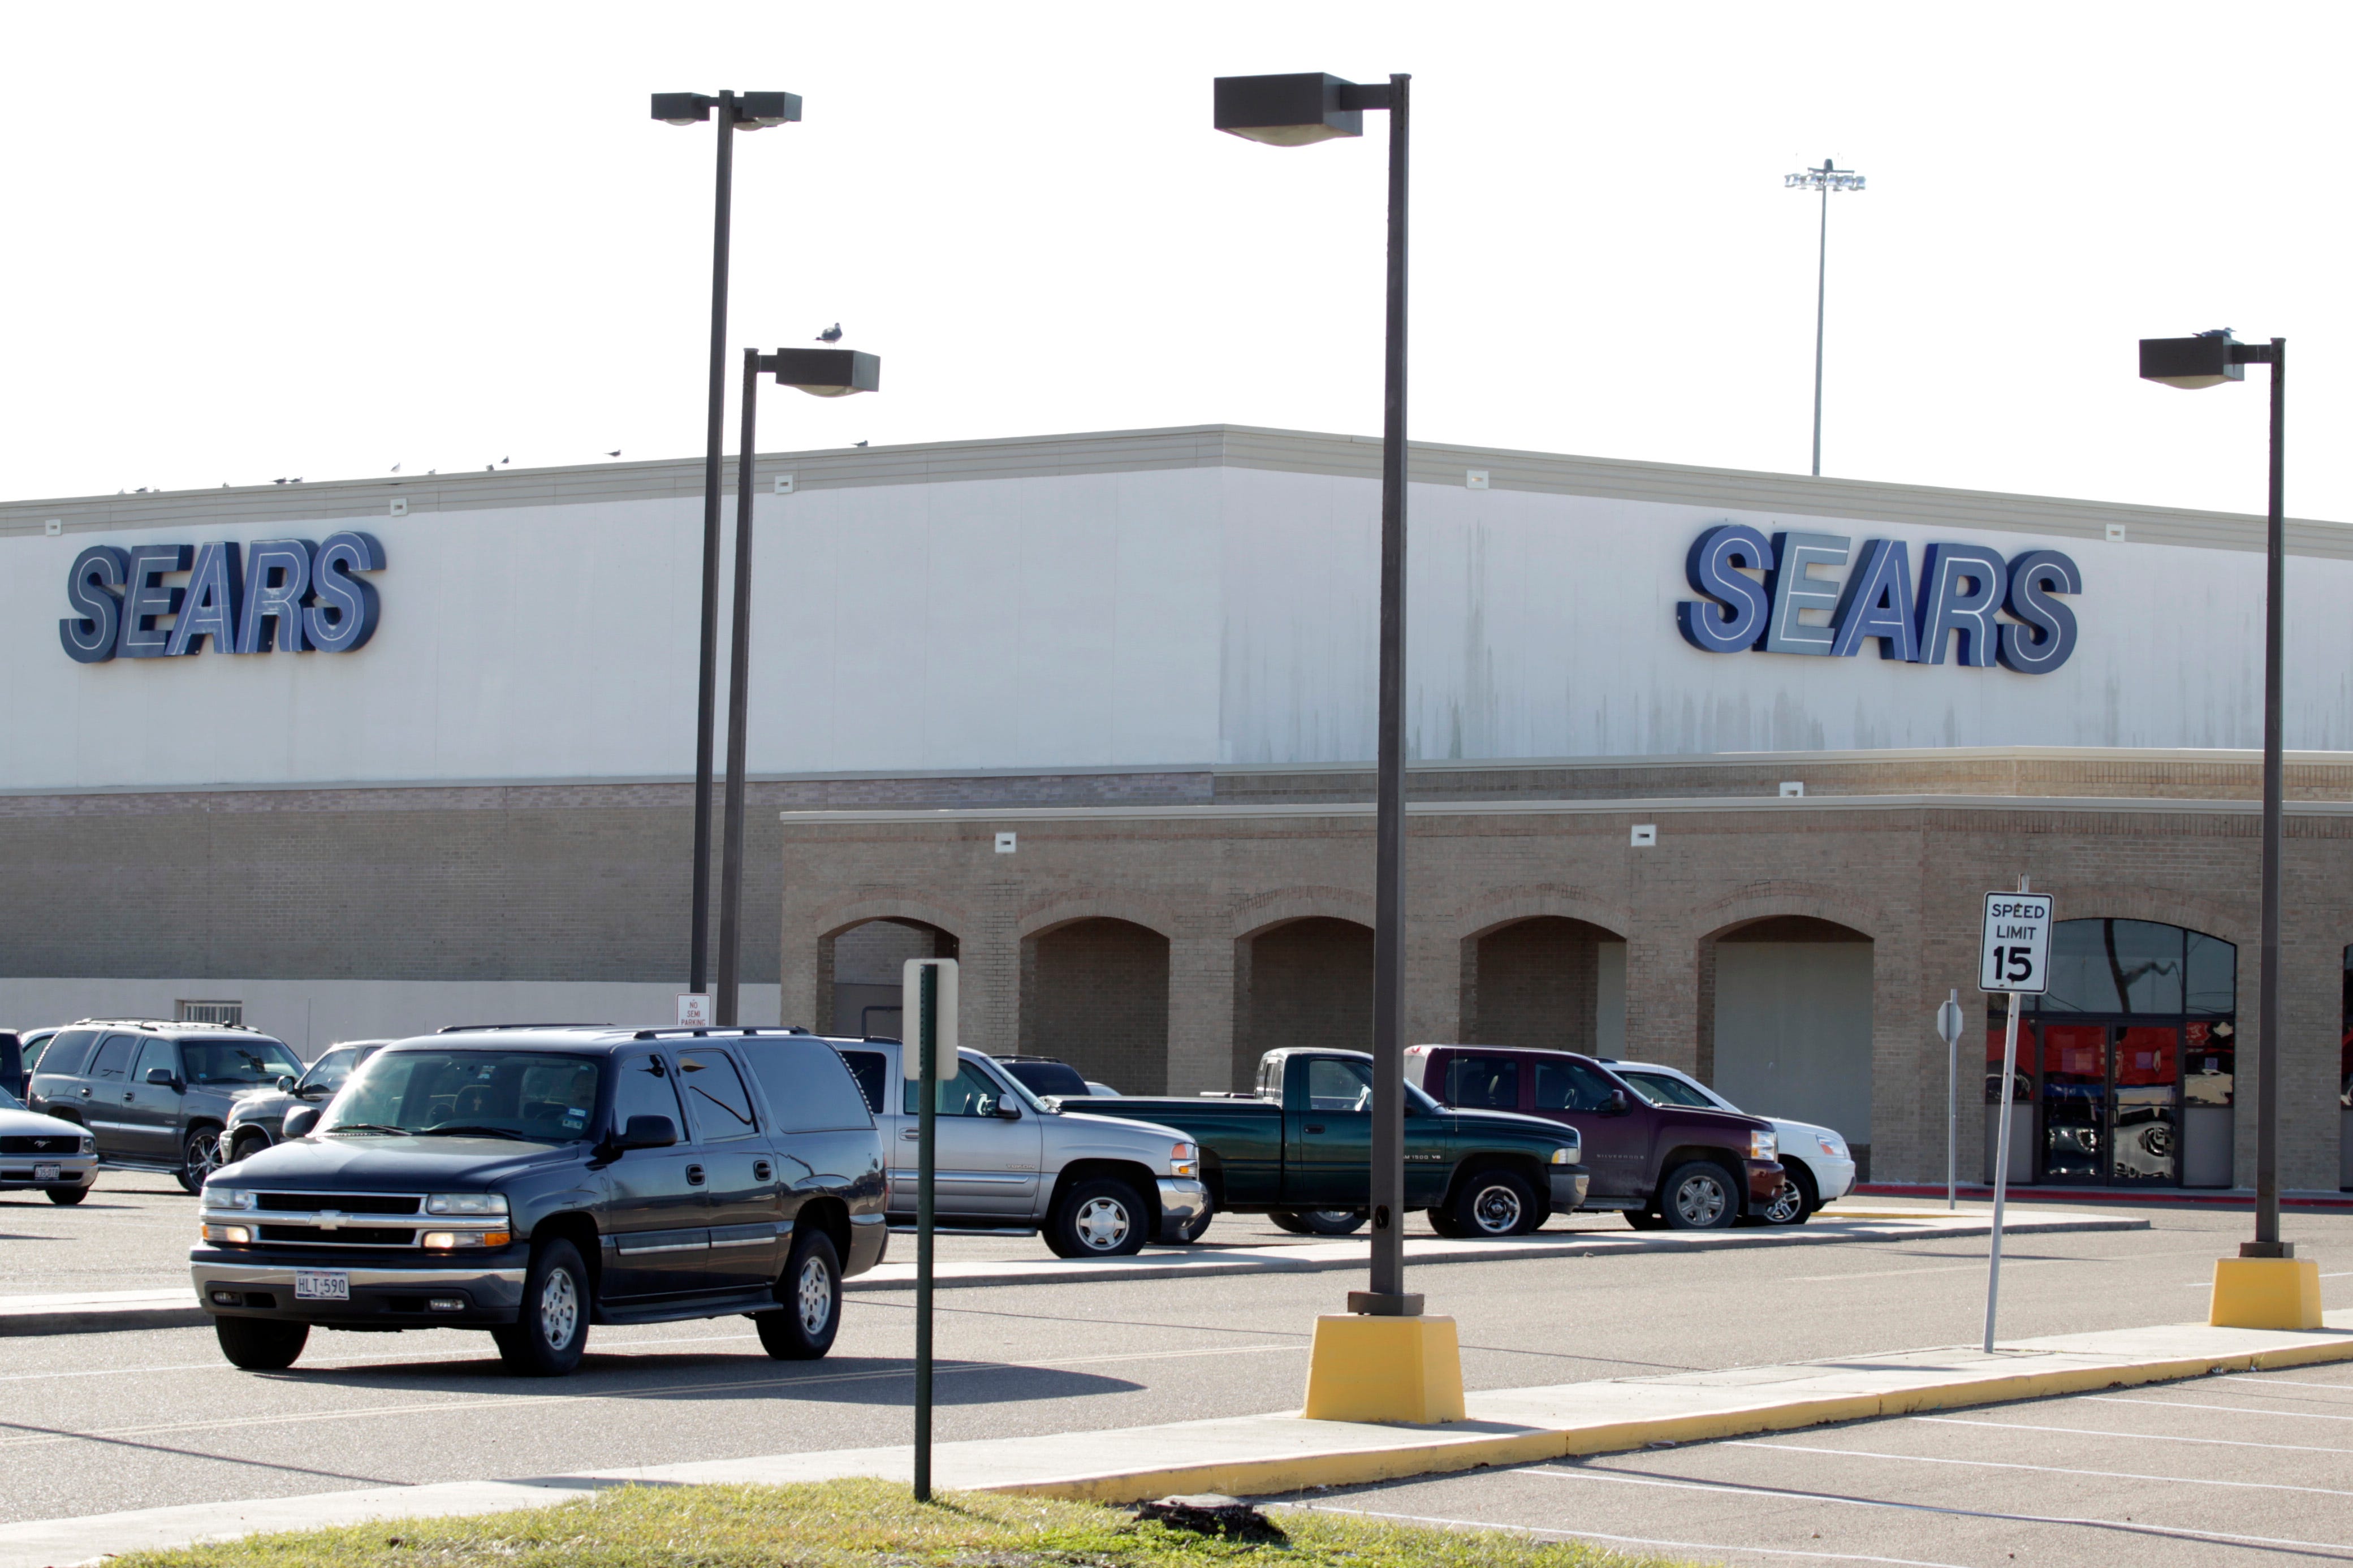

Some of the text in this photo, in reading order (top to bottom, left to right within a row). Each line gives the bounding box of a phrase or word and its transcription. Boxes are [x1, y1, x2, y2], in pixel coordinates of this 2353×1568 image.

[59, 530, 386, 664] SEARS
[1677, 524, 2082, 675] SEARS
[1991, 903, 2045, 918] SPEED
[1996, 925, 2036, 940] LIMIT
[1993, 945, 2032, 982] 15
